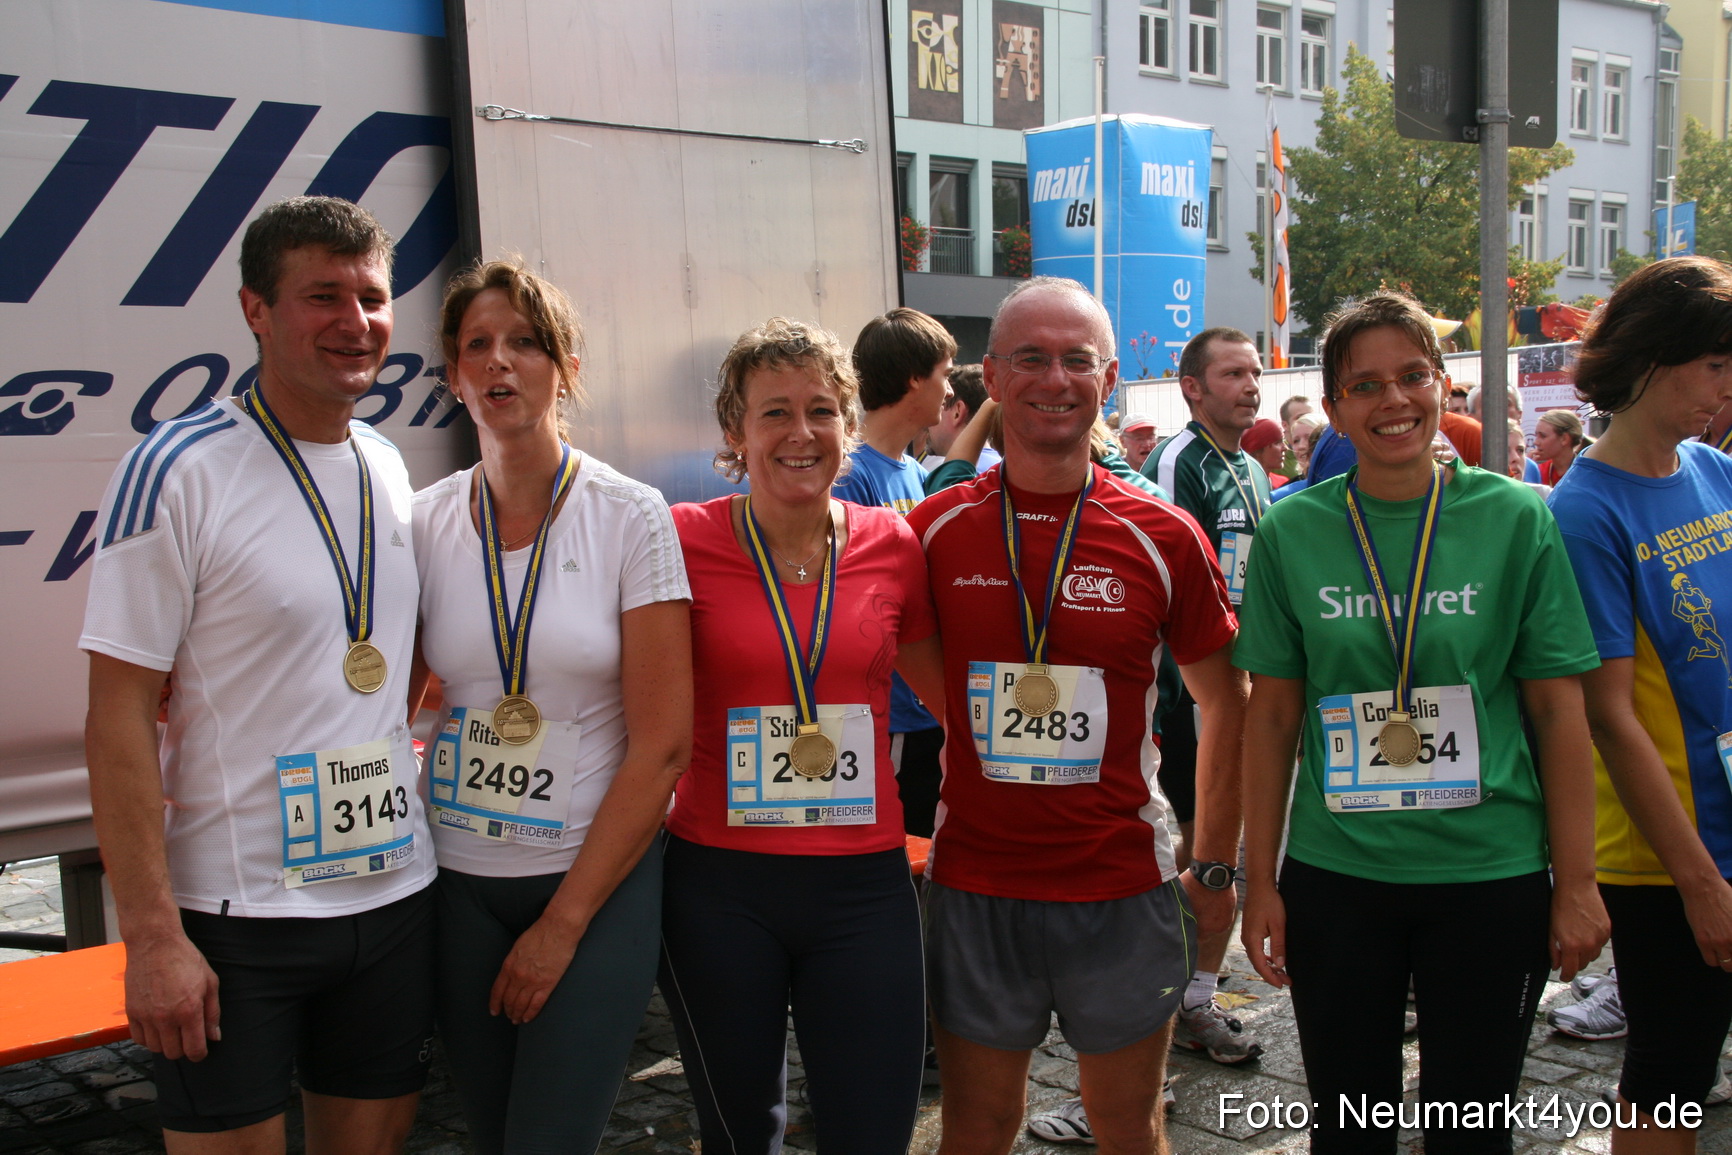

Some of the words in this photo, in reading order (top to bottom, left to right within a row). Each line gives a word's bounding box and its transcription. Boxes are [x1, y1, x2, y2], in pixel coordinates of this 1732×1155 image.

[1032, 157, 1091, 203] maxi
[1140, 160, 1195, 198] maxi
[1181, 200, 1203, 229] dsl
[1016, 513, 1049, 521] CRAFT
[1217, 508, 1246, 523] JURA
[1073, 564, 1113, 574] Laufteam
[1078, 575, 1102, 591] ASV
[1061, 601, 1095, 611] Kraftsport
[975, 704, 981, 719] B
[1002, 708, 1090, 742] 2483
[1335, 737, 1344, 753] D
[1369, 731, 1460, 767] 254
[439, 749, 446, 766] C
[738, 752, 746, 767] C
[327, 758, 389, 785] Thomas
[466, 757, 553, 801] 2492
[1048, 766, 1098, 777] PFLEIDERER
[1341, 795, 1379, 806] BOCK
[1418, 788, 1477, 800] PFLEIDERER
[295, 805, 304, 822] A
[334, 786, 408, 833] 3143
[745, 812, 784, 821] BOCK
[821, 806, 873, 817] PFLEIDERER
[440, 811, 470, 827] BOCK
[504, 822, 561, 840] PFLEIDERER
[302, 863, 346, 879] BOCK
[1518, 972, 1531, 1018] ICEPEAK
